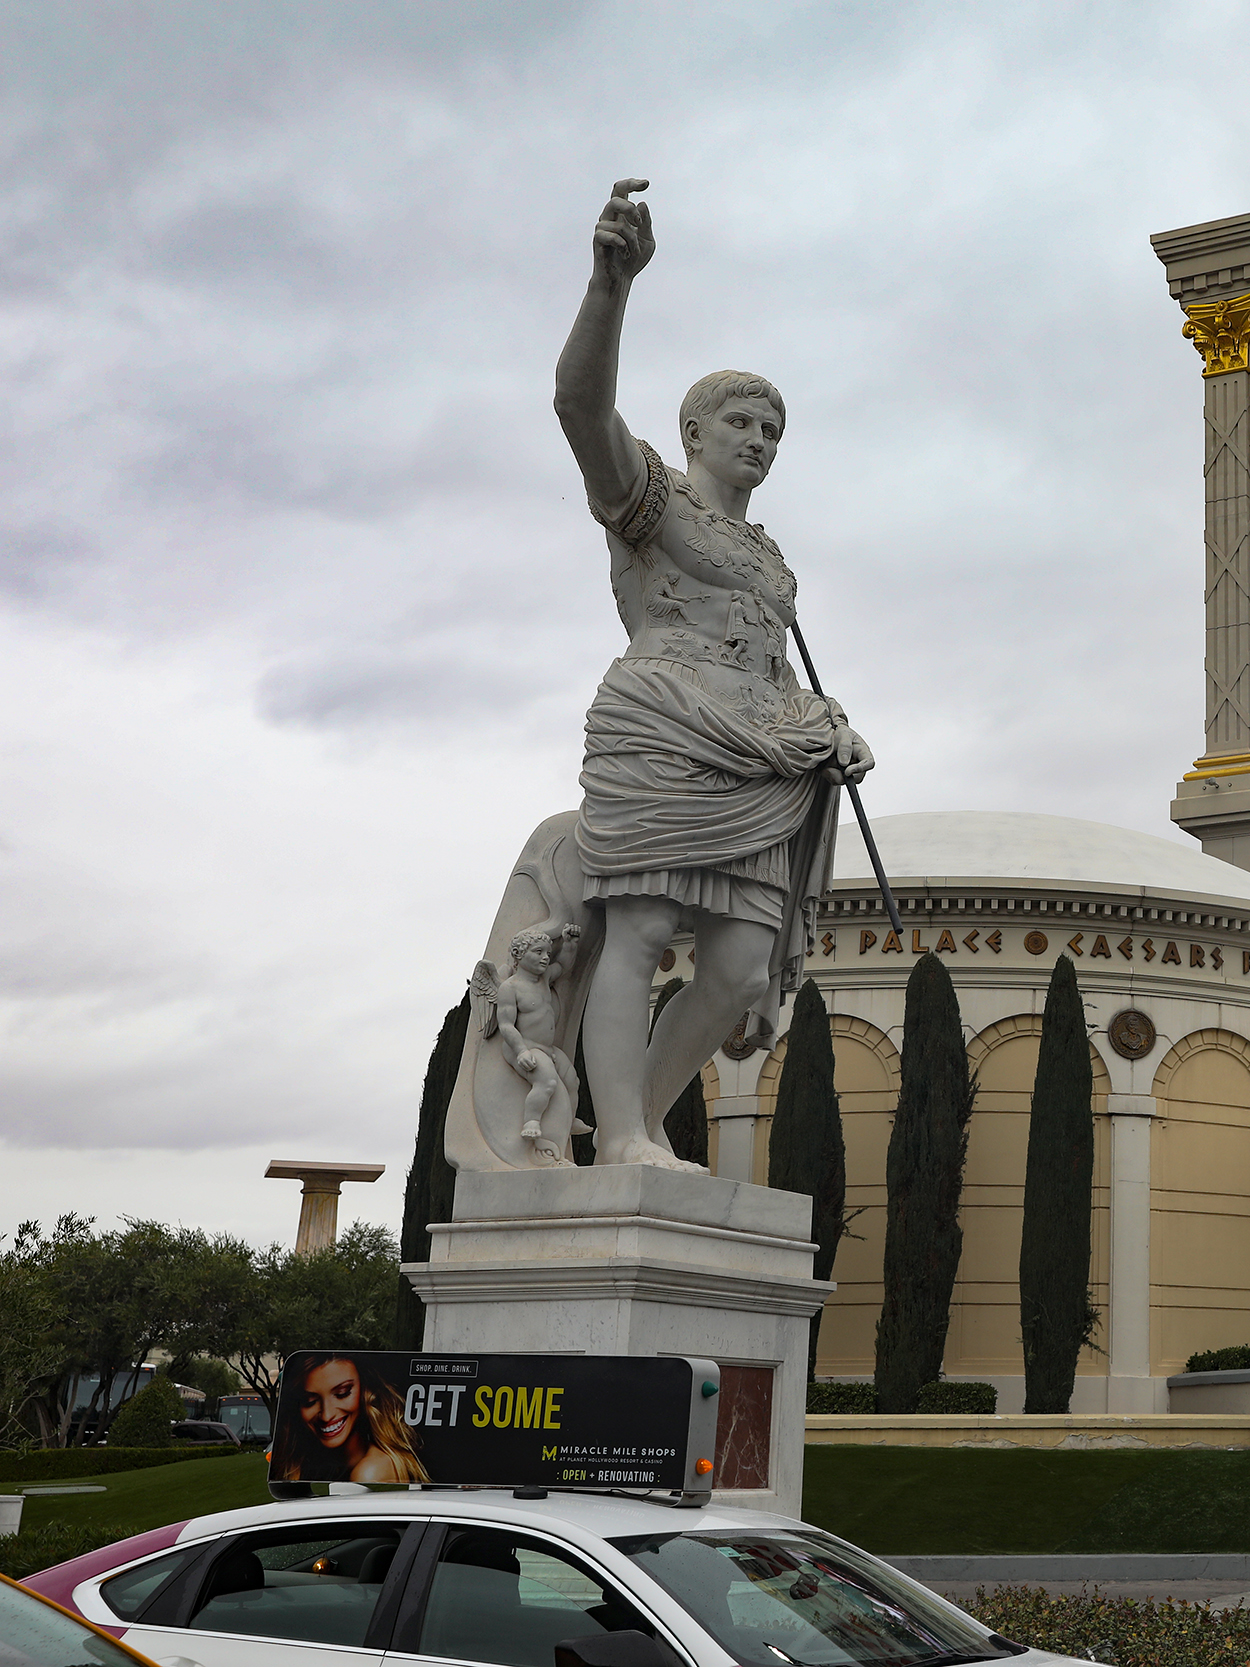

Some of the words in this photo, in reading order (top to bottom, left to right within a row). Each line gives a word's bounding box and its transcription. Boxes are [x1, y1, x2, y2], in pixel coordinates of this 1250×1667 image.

[859, 928, 1003, 955] PALACE
[1067, 932, 1224, 970] CAESARS
[415, 1364, 433, 1372] SHOP.
[434, 1364, 450, 1373] DINE.
[451, 1365, 472, 1373] DRINK.
[404, 1383, 466, 1428] GET
[472, 1385, 564, 1430] SOME
[560, 1446, 608, 1455] MIRACLE
[612, 1447, 637, 1456] MILE
[641, 1448, 676, 1457] SHOPS
[562, 1469, 587, 1481] OPEN
[598, 1470, 655, 1482] RENOVATING
